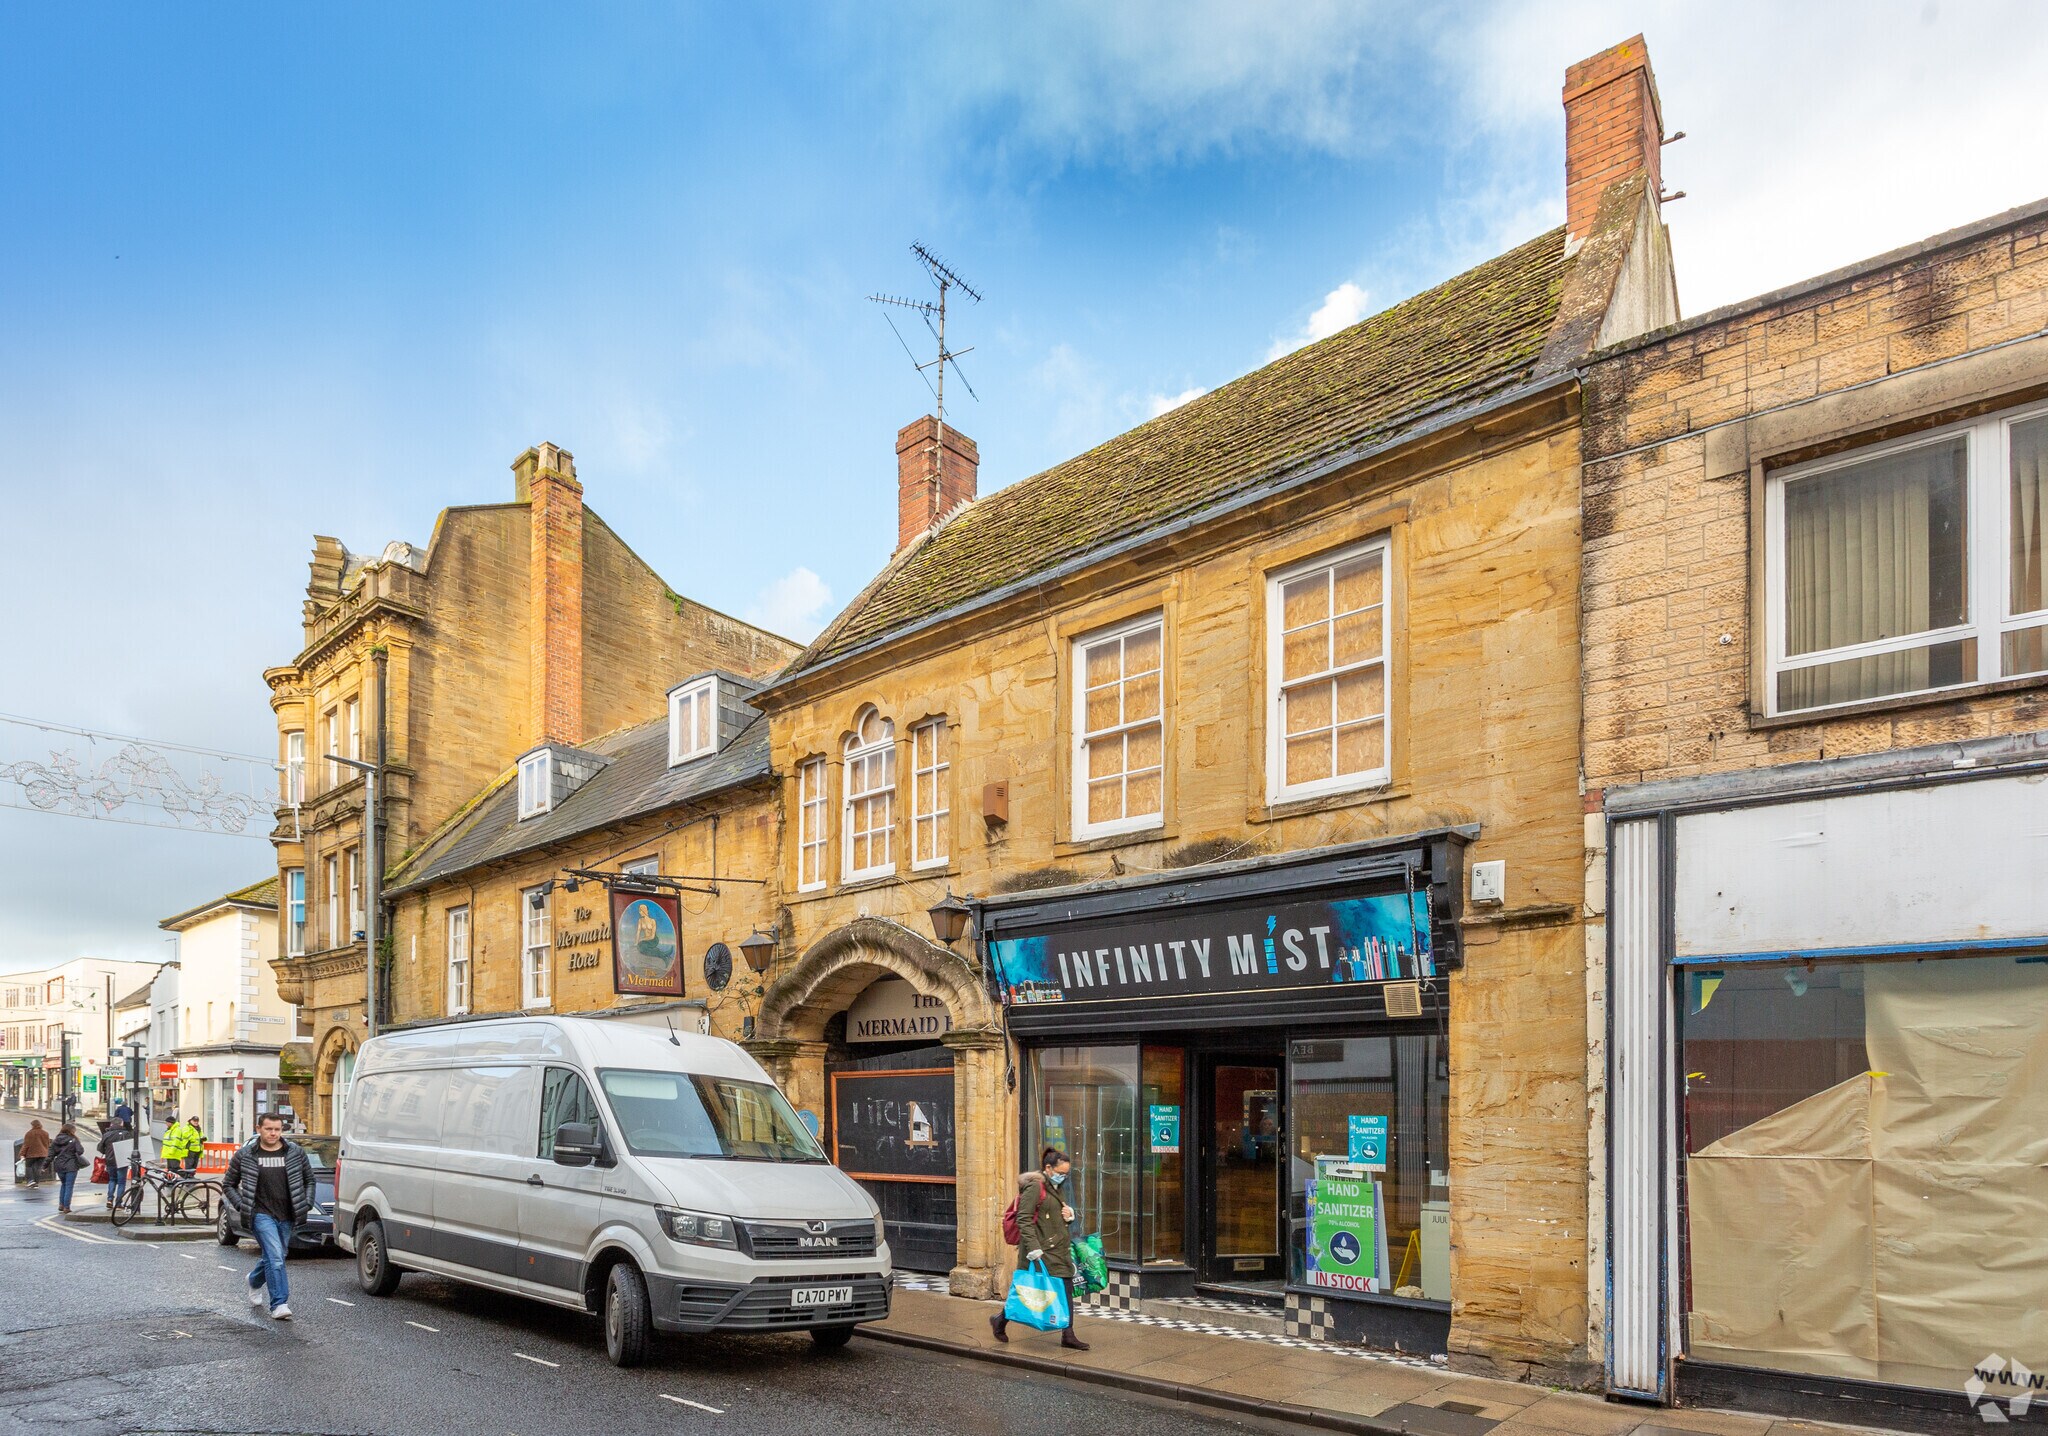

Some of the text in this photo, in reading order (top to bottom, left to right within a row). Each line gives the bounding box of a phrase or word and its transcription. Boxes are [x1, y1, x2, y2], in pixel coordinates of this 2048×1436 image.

[574, 906, 592, 921] The
[555, 921, 611, 949] Mermaid
[568, 948, 601, 972] Hotel
[1058, 938, 1211, 988] INFINITY
[627, 974, 674, 987] Mermaid
[857, 1016, 939, 1037] MERMAID
[1355, 1127, 1385, 1135] SANITIZER
[1327, 1183, 1360, 1197] HAND
[1317, 1202, 1374, 1218] SANITIZER
[1432, 1215, 1448, 1224] JUUL
[799, 1237, 838, 1247] MAN
[1315, 1271, 1371, 1292] IN STOCK
[797, 1289, 849, 1304] CA70 PWY
